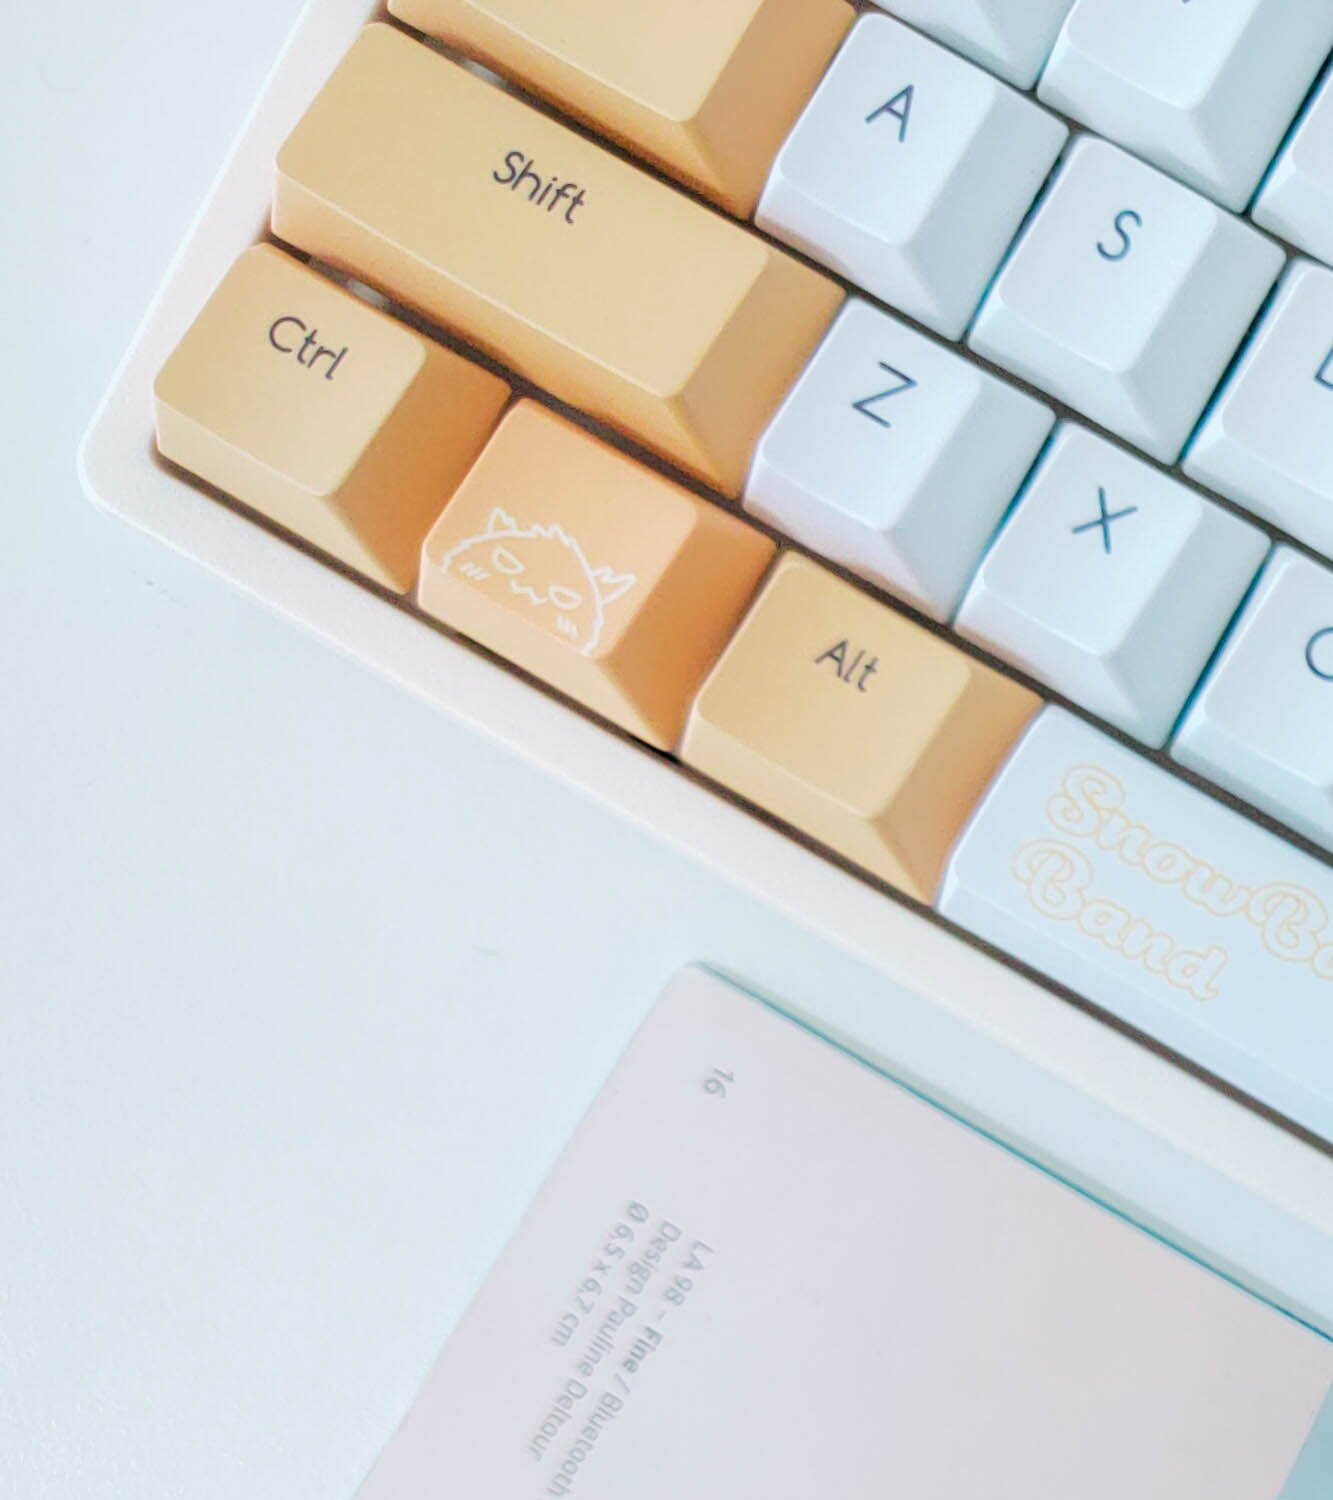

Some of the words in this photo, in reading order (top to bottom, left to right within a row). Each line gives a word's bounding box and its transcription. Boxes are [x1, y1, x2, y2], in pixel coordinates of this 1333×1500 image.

[864, 84, 915, 143] A
[492, 150, 586, 225] Shift
[1096, 209, 1142, 262] S
[268, 315, 349, 381] Ctrl
[851, 361, 917, 428] Z
[1071, 486, 1137, 554] X
[814, 640, 878, 693] Alt
[1011, 839, 1229, 1001] Band
[701, 1067, 735, 1099] 16
[591, 1259, 612, 1275] x
[625, 1220, 683, 1295] Design
[681, 1239, 715, 1271] LA
[660, 1274, 693, 1307] 98
[551, 1313, 579, 1347] cm
[575, 1295, 638, 1377] Pauline
[620, 1325, 664, 1374] Fine
[614, 1373, 631, 1394] /
[527, 1378, 588, 1462] Deltour
[546, 1391, 624, 1498] Bluetooth
